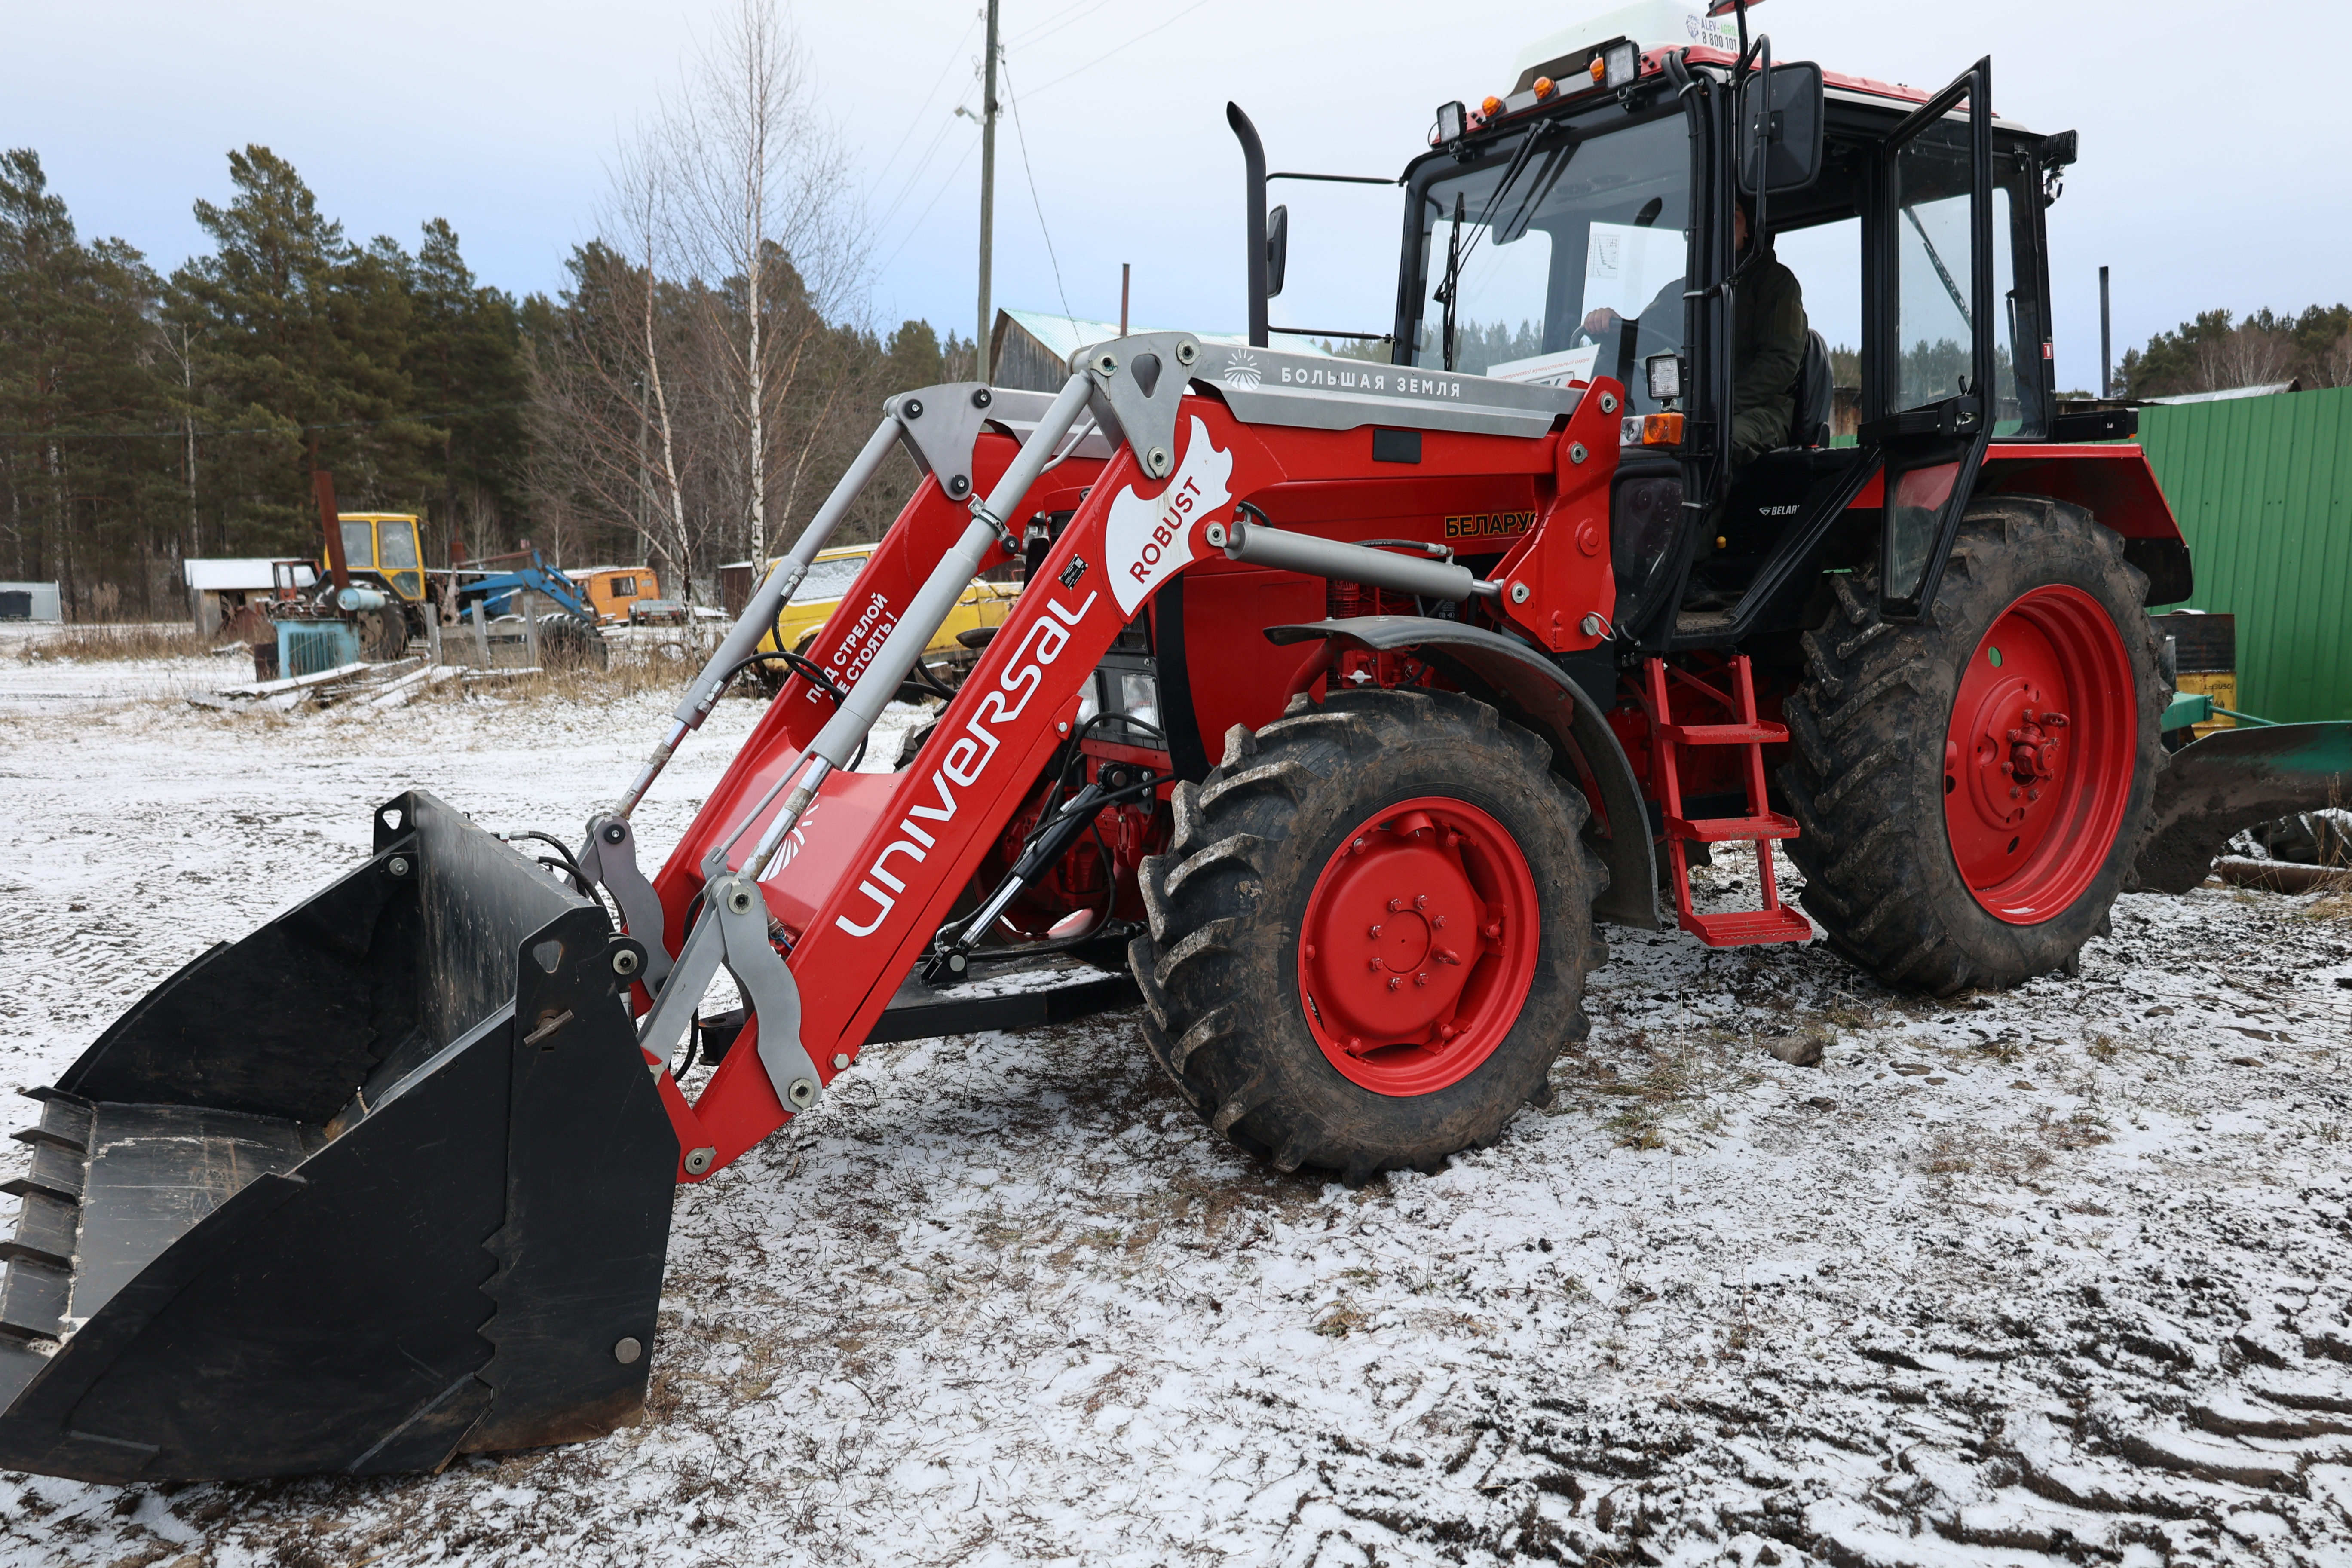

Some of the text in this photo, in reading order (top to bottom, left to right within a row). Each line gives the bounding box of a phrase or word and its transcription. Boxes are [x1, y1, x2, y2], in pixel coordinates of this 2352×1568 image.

[1701, 18, 1738, 36] ALEV-AGRO.
[1702, 31, 1707, 44] 8
[1709, 34, 1724, 48] 800
[1725, 37, 1737, 51] 101
[1532, 360, 1574, 374] муниципальный
[1282, 368, 1460, 397] БОЛЬШАЯ ЗЕМЛЯ
[1771, 505, 1800, 515] BELAR
[1129, 475, 1201, 584] ROBUST
[833, 592, 888, 666] СТРЕЛОЙ
[829, 680, 851, 701] Е
